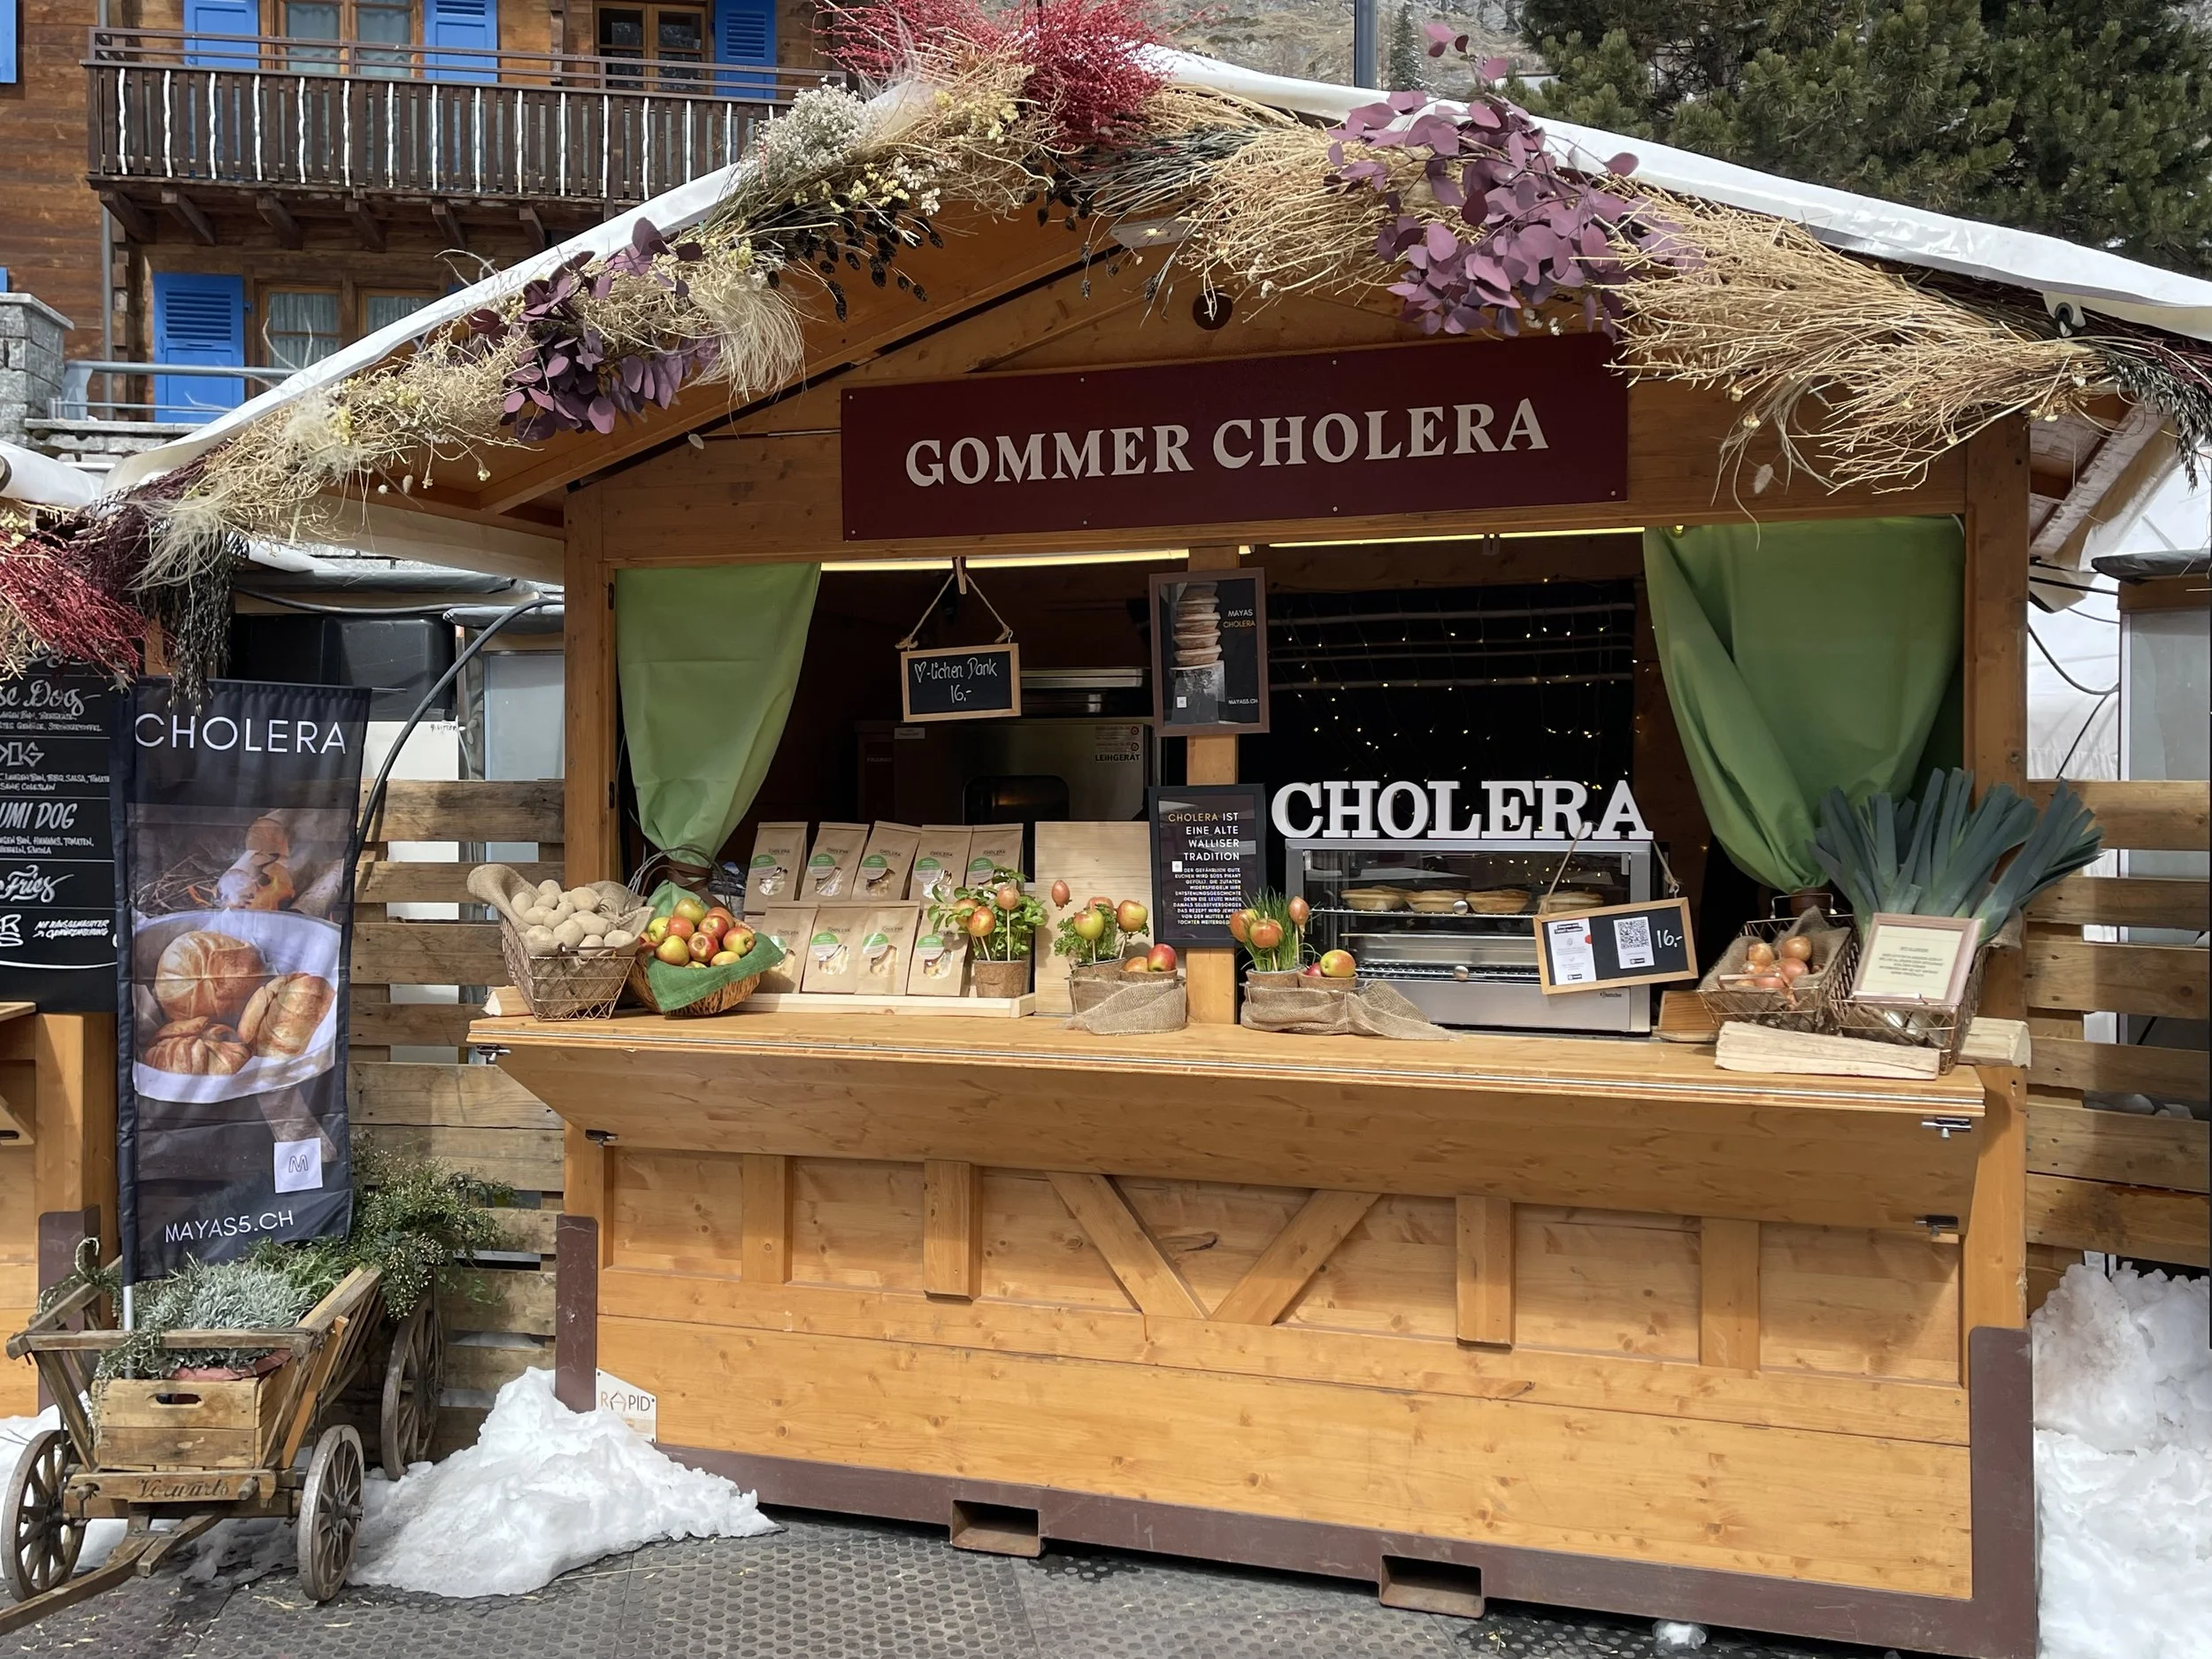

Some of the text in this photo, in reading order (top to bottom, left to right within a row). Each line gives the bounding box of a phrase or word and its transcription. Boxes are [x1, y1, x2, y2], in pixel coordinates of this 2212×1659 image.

[906, 397, 1549, 488] GOMMER CHOLERA
[1227, 609, 1254, 618] MAYAS
[967, 657, 997, 680] Dank
[134, 712, 347, 755] CHOLERA
[35, 802, 78, 830] DOG
[1168, 812, 1239, 822] CHOLERA IST
[1271, 780, 1654, 840] CHOLERA
[1186, 826, 1239, 835] EINE ALTE
[1188, 839, 1240, 848] WALLISER
[1184, 851, 1240, 861] TRADITION
[4, 864, 74, 902] Fries
[288, 1154, 309, 1173] M
[165, 1210, 294, 1243] MAYAS5.CH
[601, 1390, 651, 1412] RAPID
